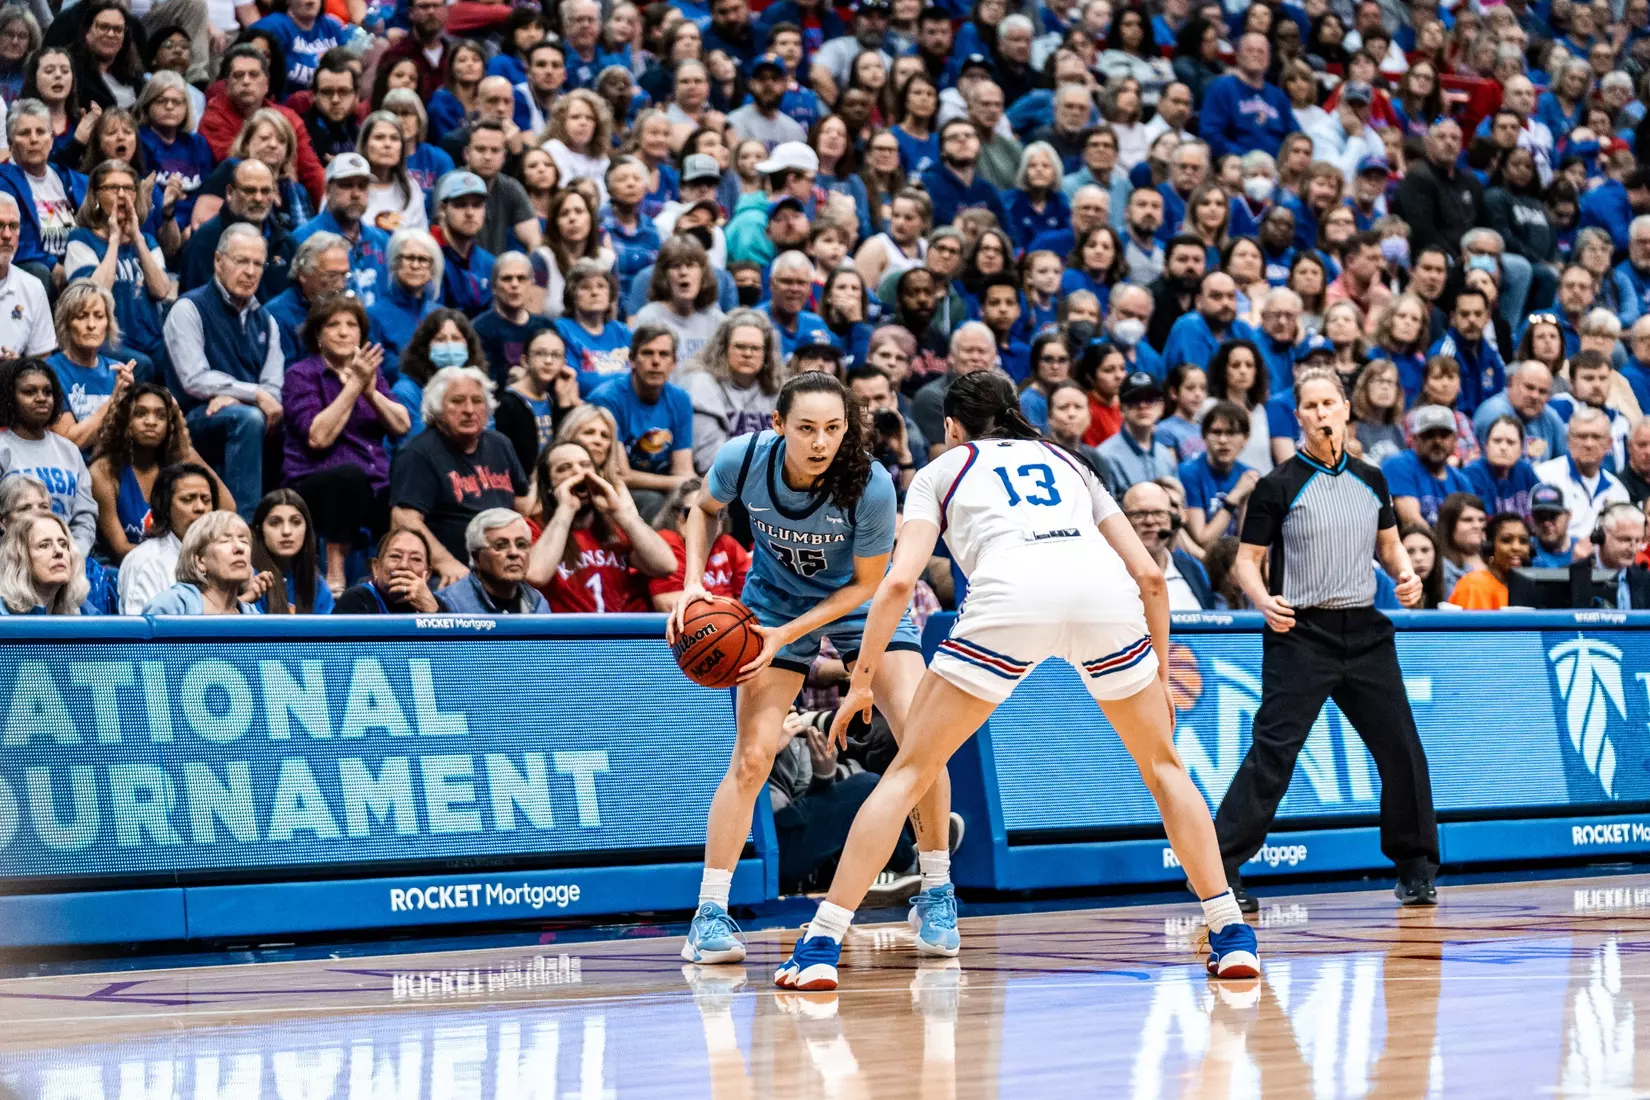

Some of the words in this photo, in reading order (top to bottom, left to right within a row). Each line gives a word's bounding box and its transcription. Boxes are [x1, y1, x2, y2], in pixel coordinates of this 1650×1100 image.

[993, 464, 1062, 507] 13
[750, 515, 845, 545] COLUMBIA
[584, 572, 606, 612] 1
[415, 618, 455, 629] ROCKET
[456, 618, 497, 631] Mortgage
[673, 623, 717, 661] Wilson
[690, 648, 726, 679] NCAA
[1572, 824, 1631, 845] ROCKET
[1250, 843, 1308, 867] rtgage
[390, 884, 482, 912] ROCKET
[485, 882, 581, 910] Mortgage
